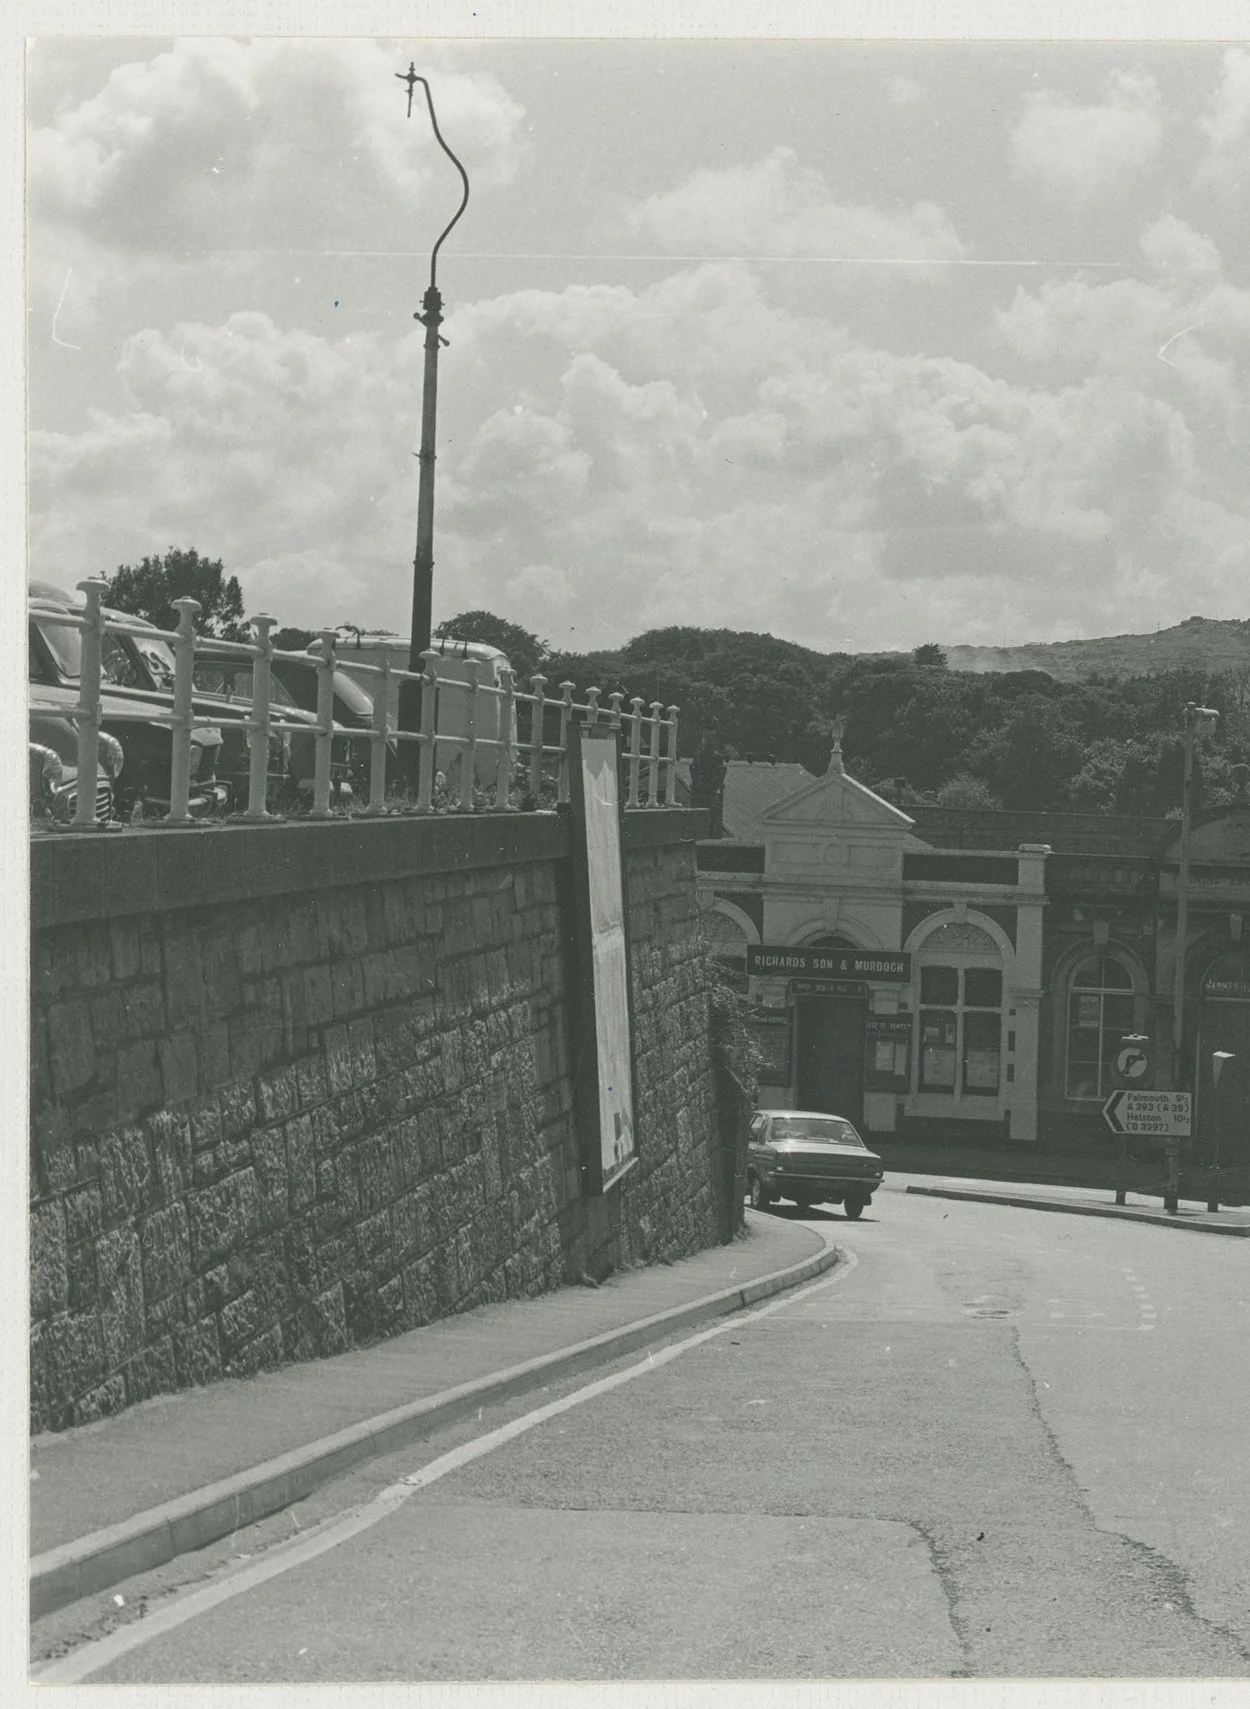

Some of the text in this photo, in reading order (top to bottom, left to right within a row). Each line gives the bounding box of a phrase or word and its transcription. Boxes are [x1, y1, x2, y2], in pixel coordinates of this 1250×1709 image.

[755, 954, 904, 973] RICHARDS SON & MURDOCH
[1127, 1093, 1169, 1102] Falmouth
[1127, 1113, 1162, 1122] Helston
